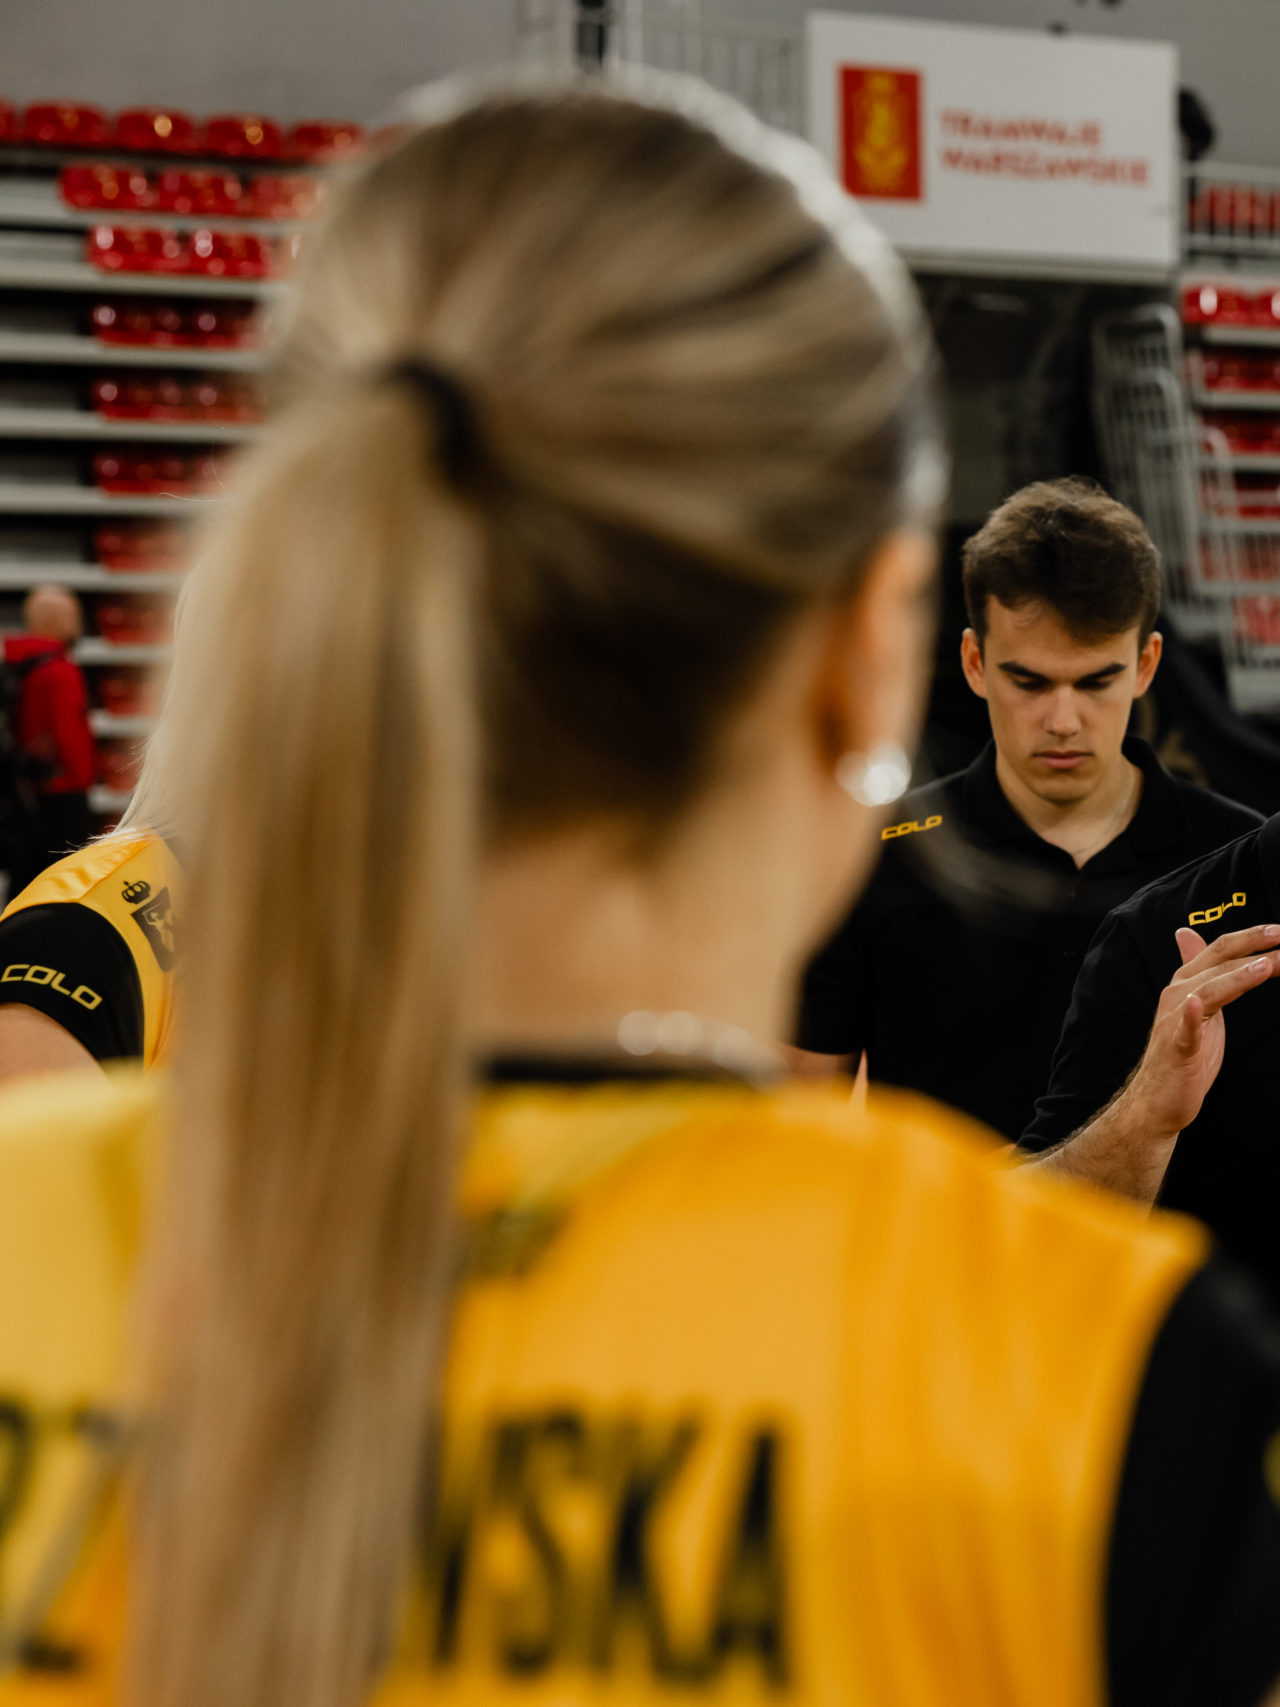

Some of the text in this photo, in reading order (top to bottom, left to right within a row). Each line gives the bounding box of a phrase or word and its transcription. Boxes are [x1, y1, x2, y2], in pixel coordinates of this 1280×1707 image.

[942, 110, 1101, 146] TRAMWAJE
[942, 148, 1149, 187] WARSZAWSKIE
[881, 815, 943, 840] COLO
[1188, 892, 1247, 926] COLO
[0, 964, 103, 1010] COLO
